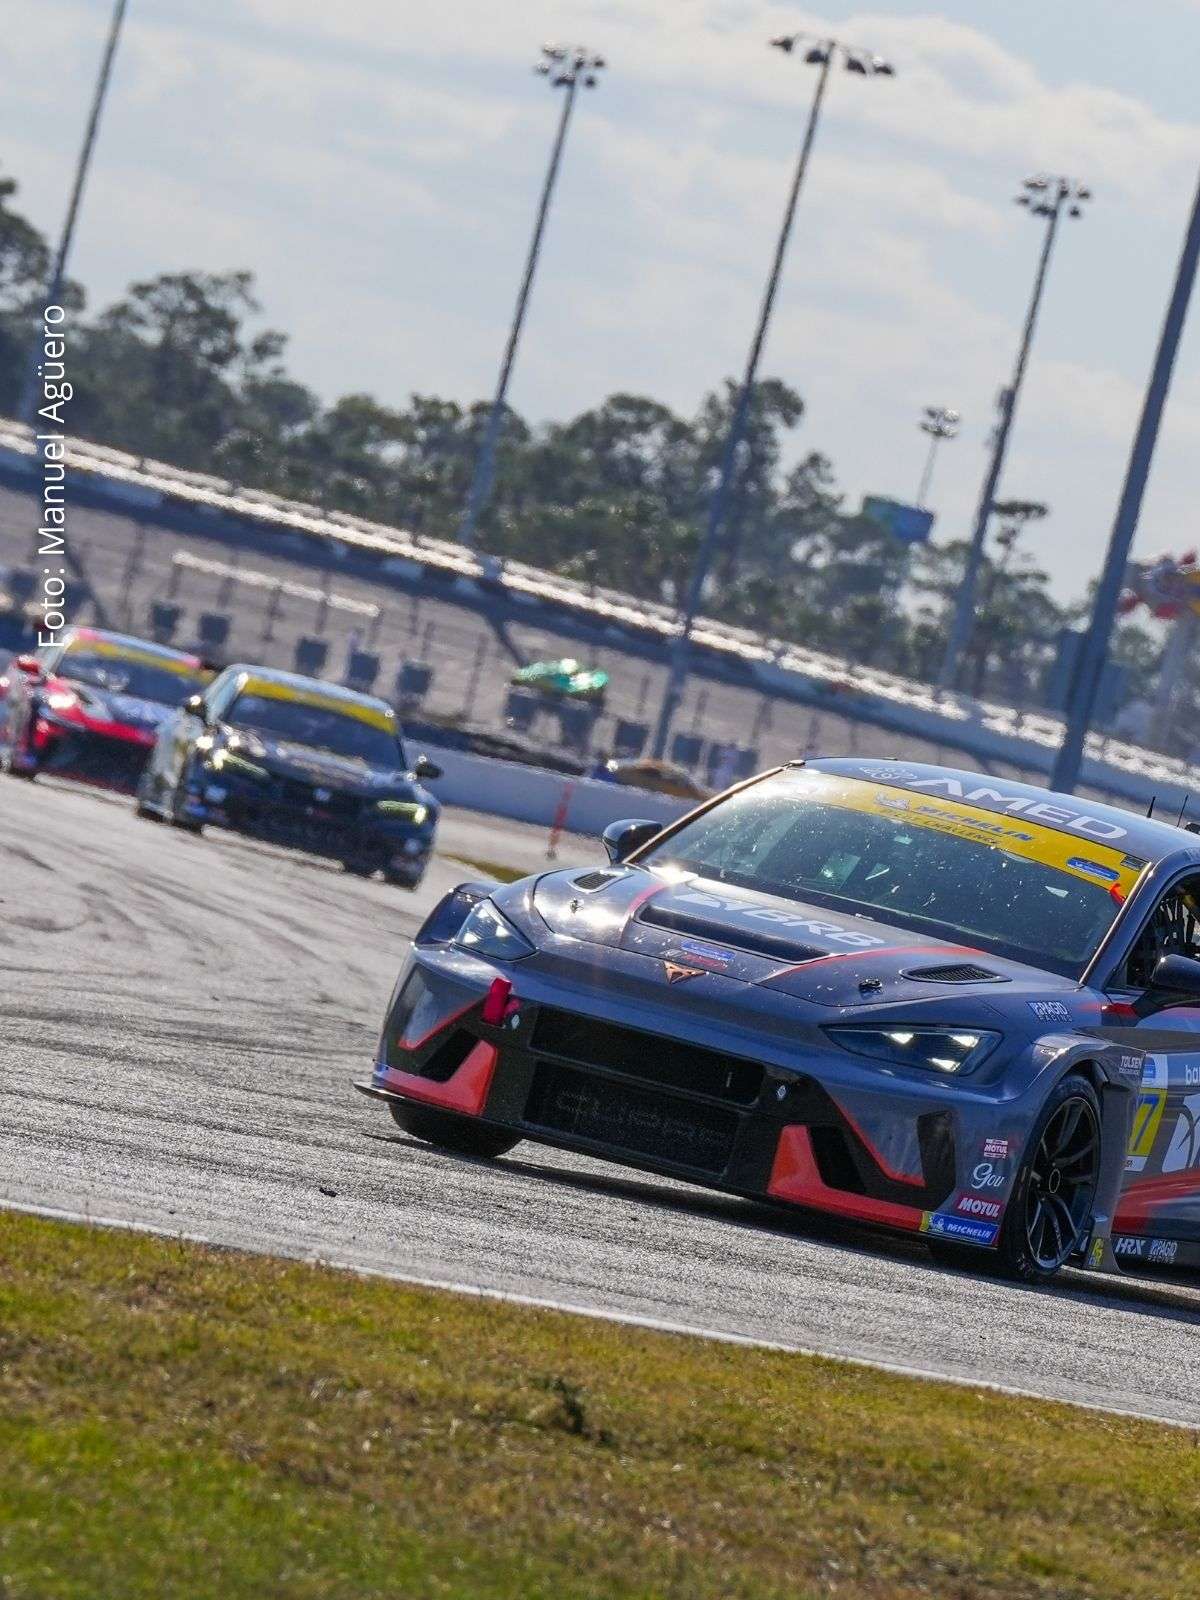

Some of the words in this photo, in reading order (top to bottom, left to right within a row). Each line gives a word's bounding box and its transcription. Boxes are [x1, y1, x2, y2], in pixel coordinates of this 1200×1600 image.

[905, 777, 1128, 839] AMED
[742, 908, 886, 947] BRB
[983, 1144, 1009, 1155] MOTUL
[957, 1197, 1001, 1218] MOTUL
[946, 1222, 993, 1239] MICHELIN
